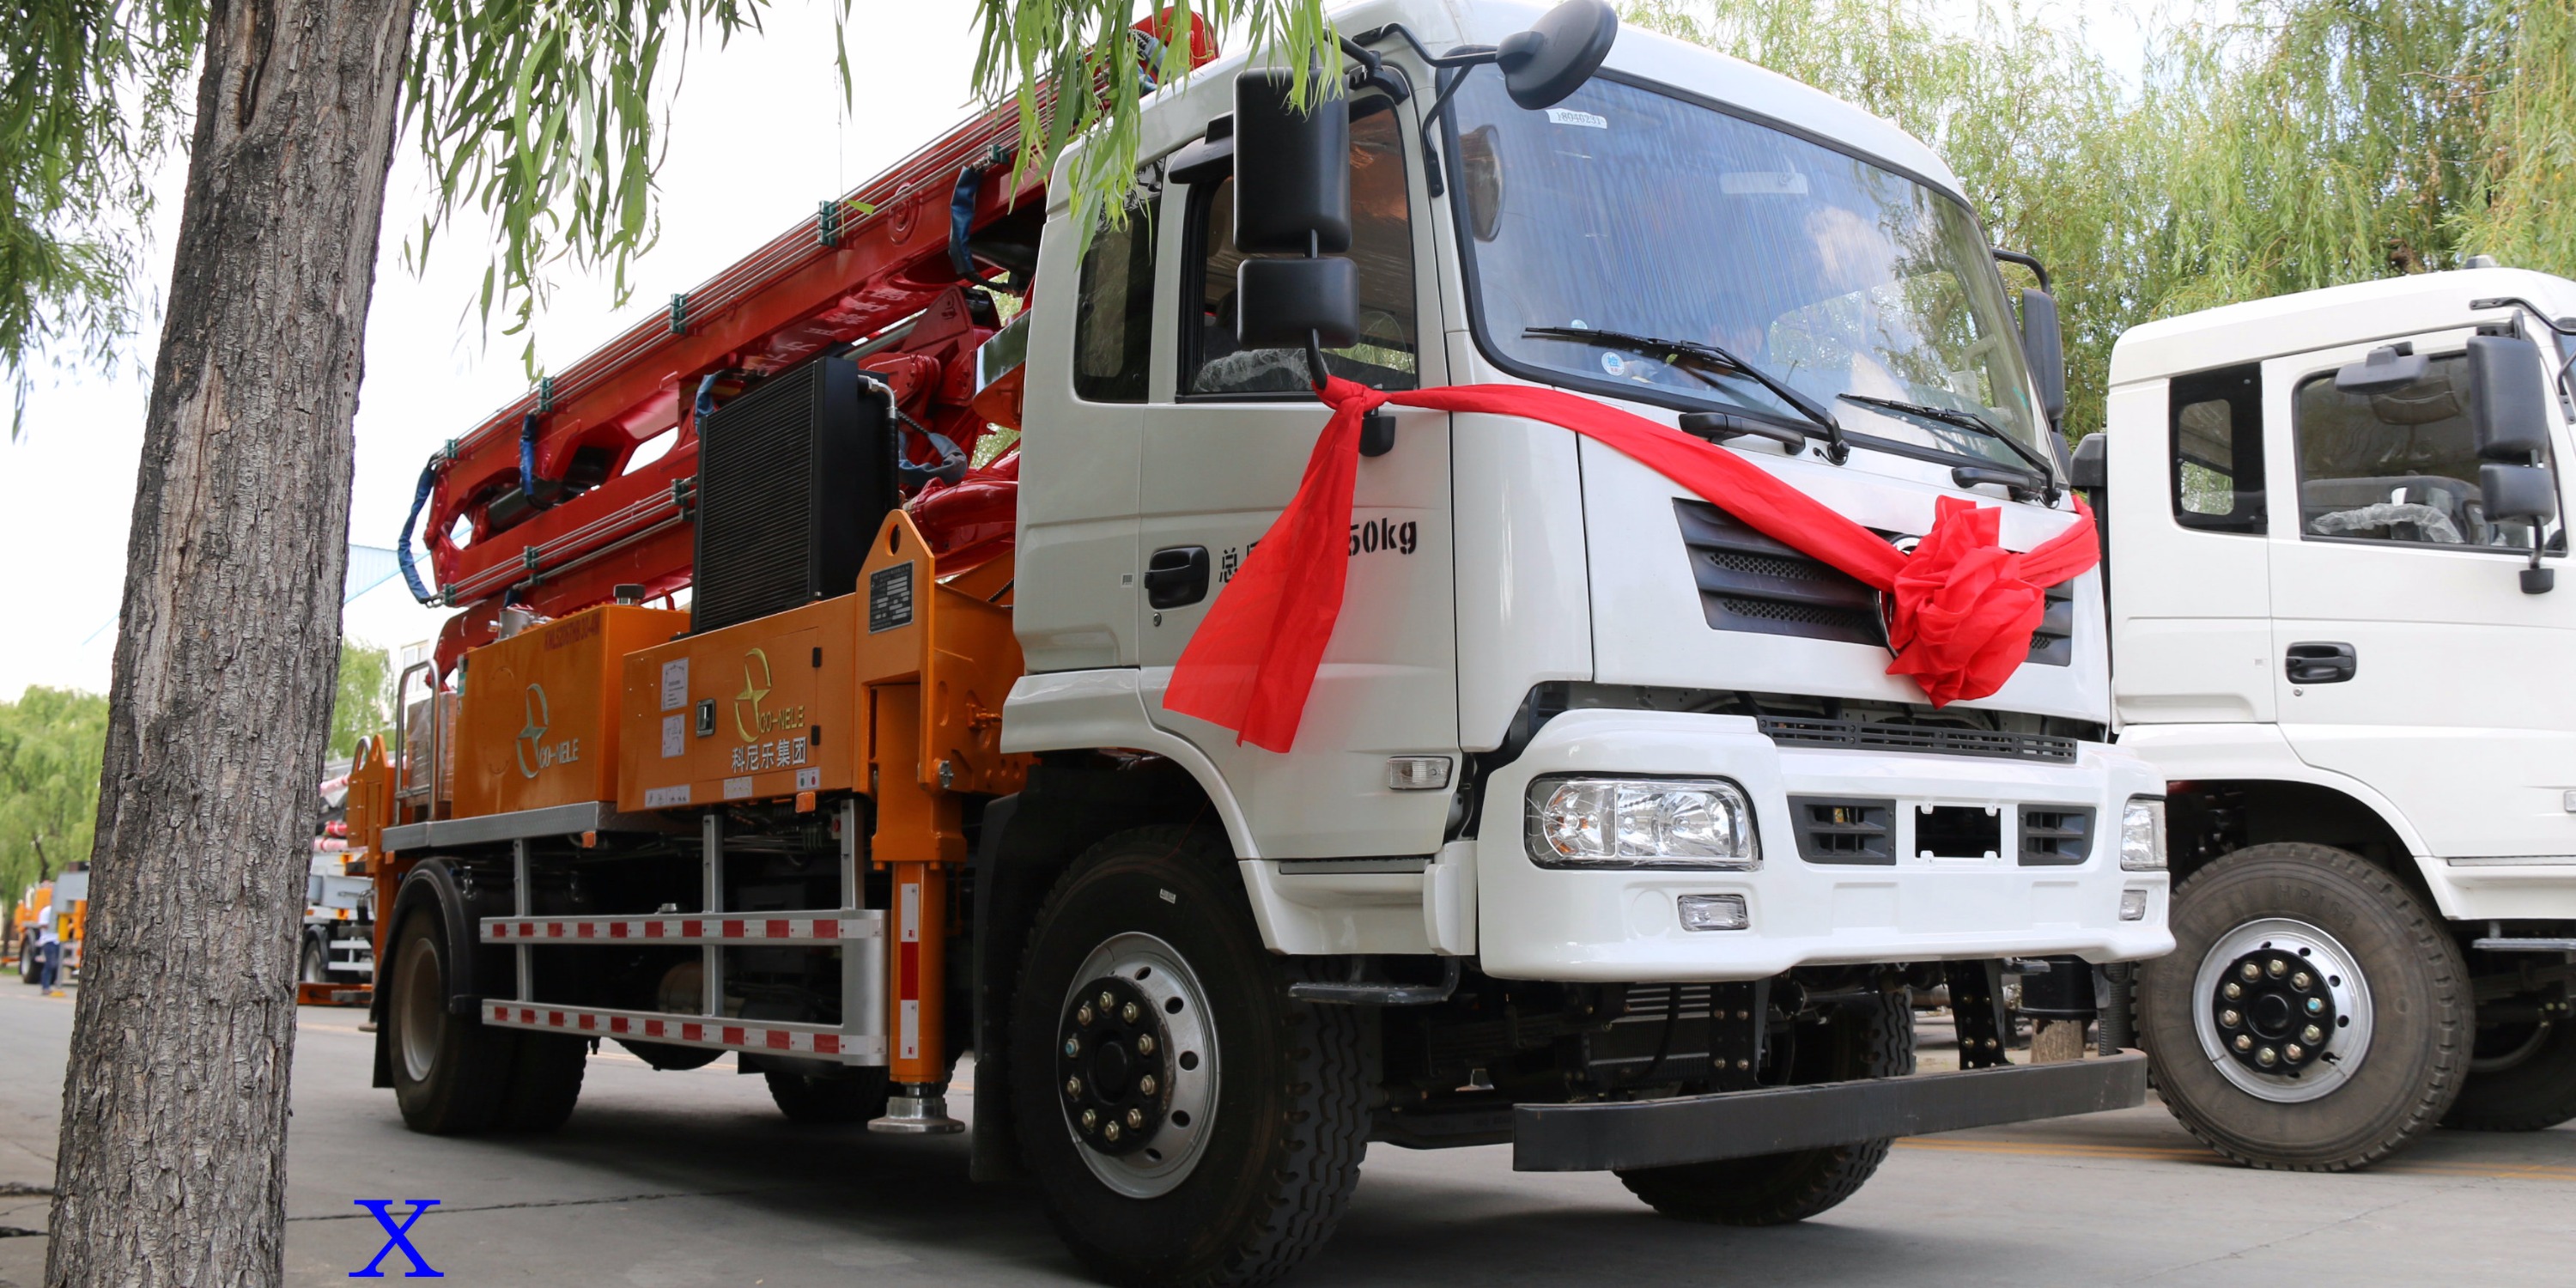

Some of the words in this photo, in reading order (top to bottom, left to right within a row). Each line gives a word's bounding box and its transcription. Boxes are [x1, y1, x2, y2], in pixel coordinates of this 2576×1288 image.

[731, 736, 808, 774] 科尼乐集团
